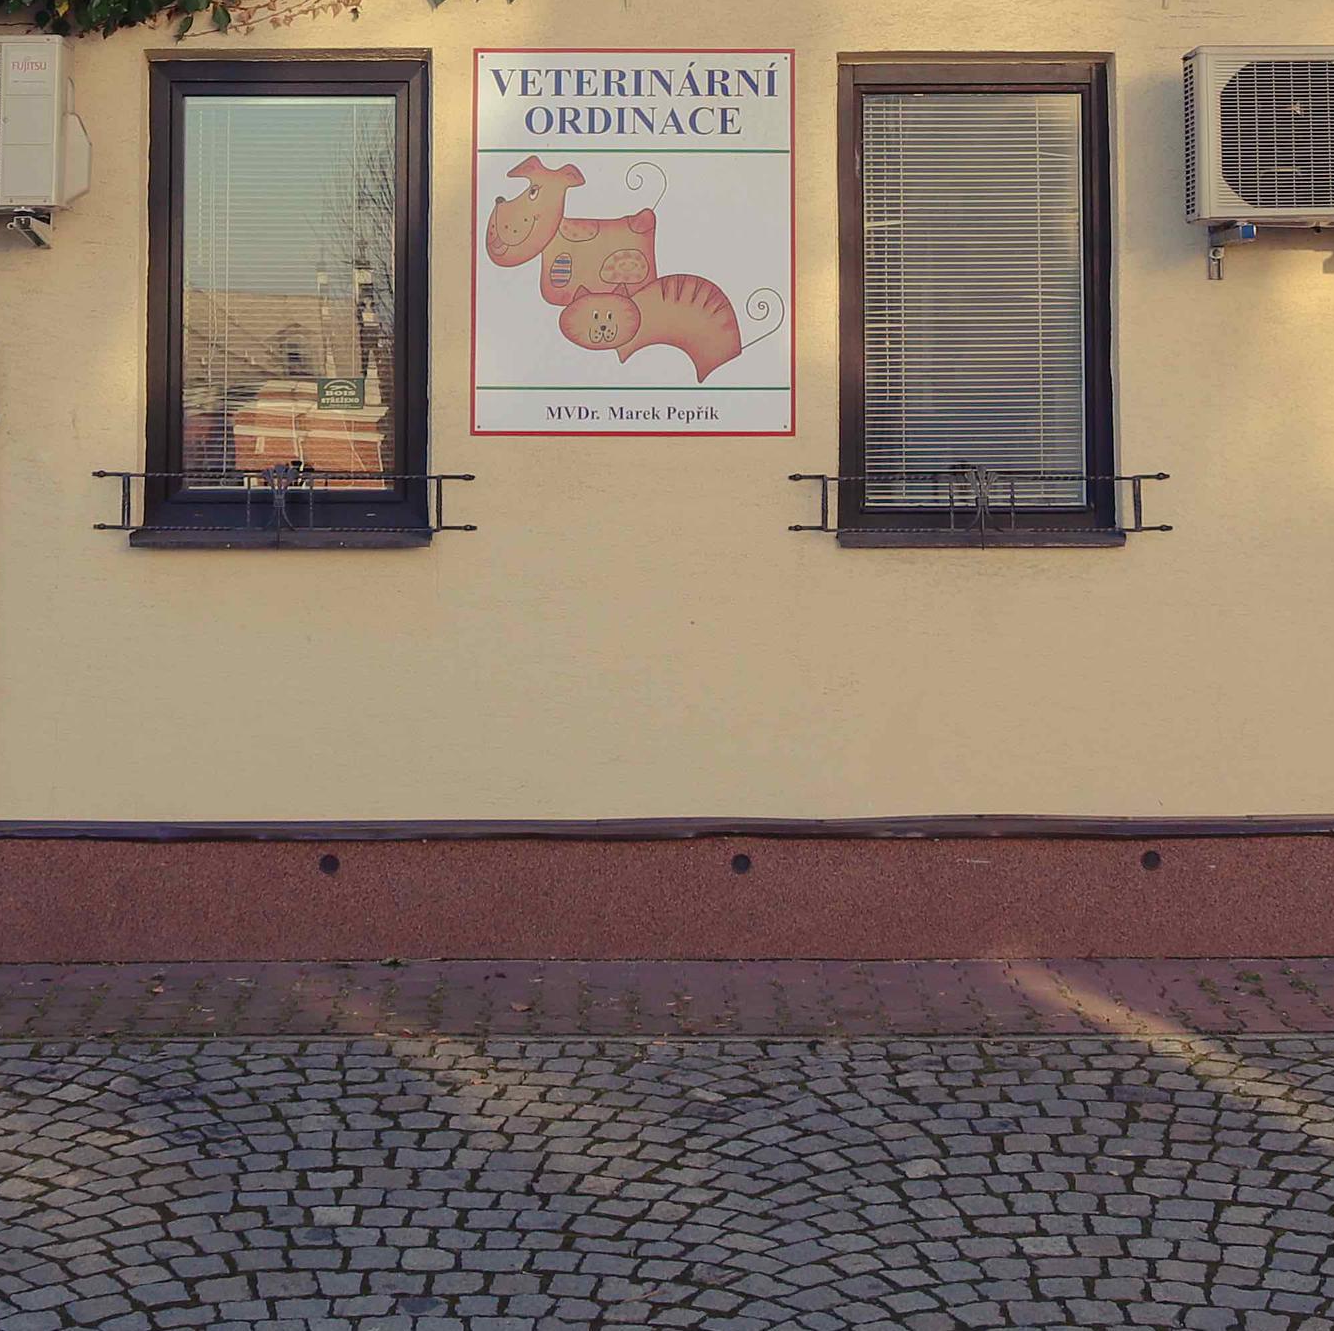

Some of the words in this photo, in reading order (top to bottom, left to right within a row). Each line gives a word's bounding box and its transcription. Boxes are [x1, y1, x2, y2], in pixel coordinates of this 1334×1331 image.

[11, 58, 47, 72] FUJITSU
[490, 61, 779, 98] VETERINÁRNÍ
[524, 106, 743, 135] ORDINACE
[546, 406, 601, 420] MVDr.
[607, 406, 661, 420] Marek
[666, 405, 720, 424] Pepřík
